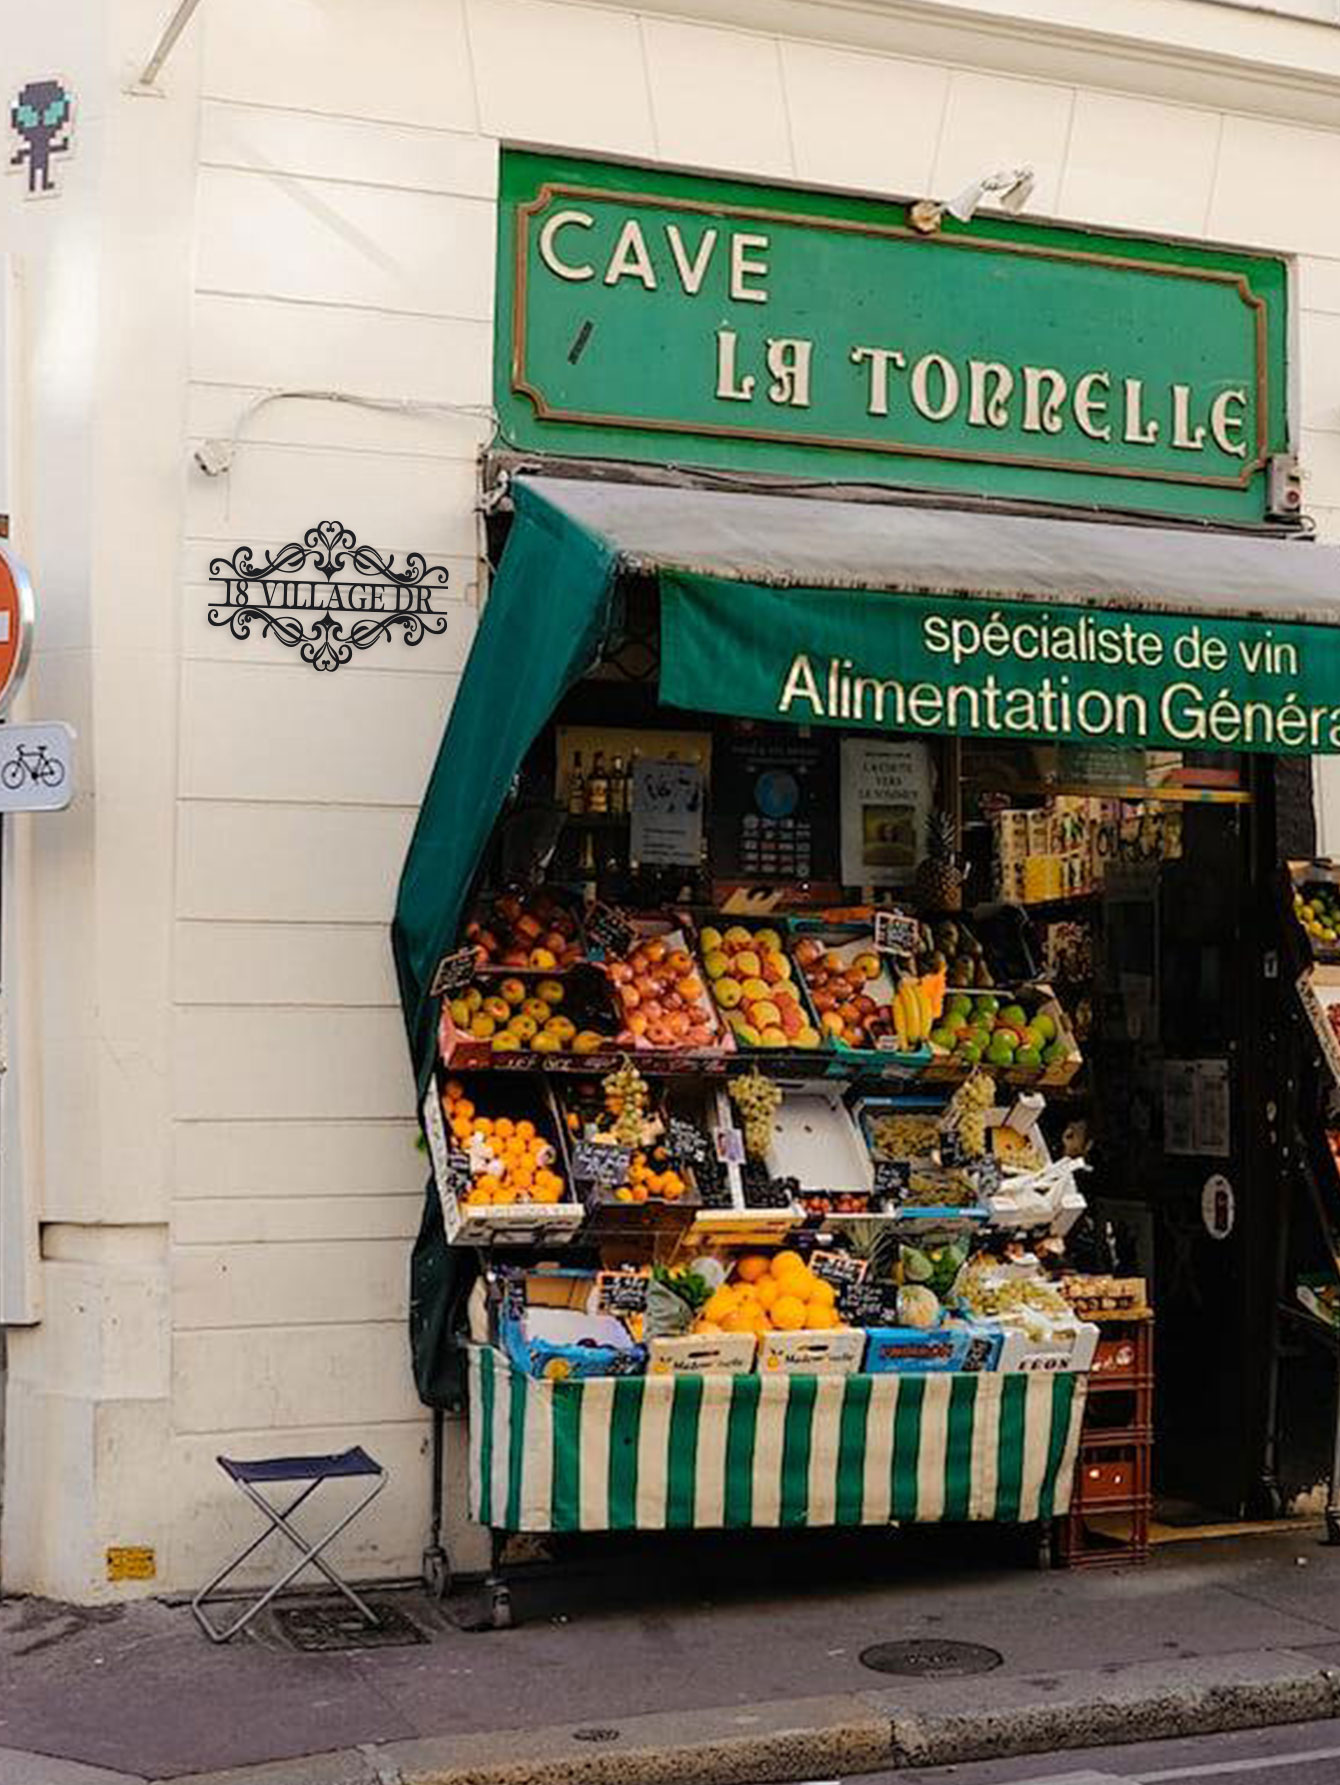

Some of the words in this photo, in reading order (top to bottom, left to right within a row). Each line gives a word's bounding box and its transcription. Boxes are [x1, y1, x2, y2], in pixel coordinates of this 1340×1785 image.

[538, 211, 771, 304] CAVE
[714, 326, 813, 408] LA
[851, 345, 1249, 457] TONNELLE
[224, 580, 249, 606] 18
[261, 581, 385, 612] VILLAGE
[395, 584, 435, 614] DR
[923, 612, 1163, 667] spécialiste
[1172, 625, 1227, 671] de
[1238, 630, 1297, 675] vin
[777, 653, 1146, 736] Alimentation
